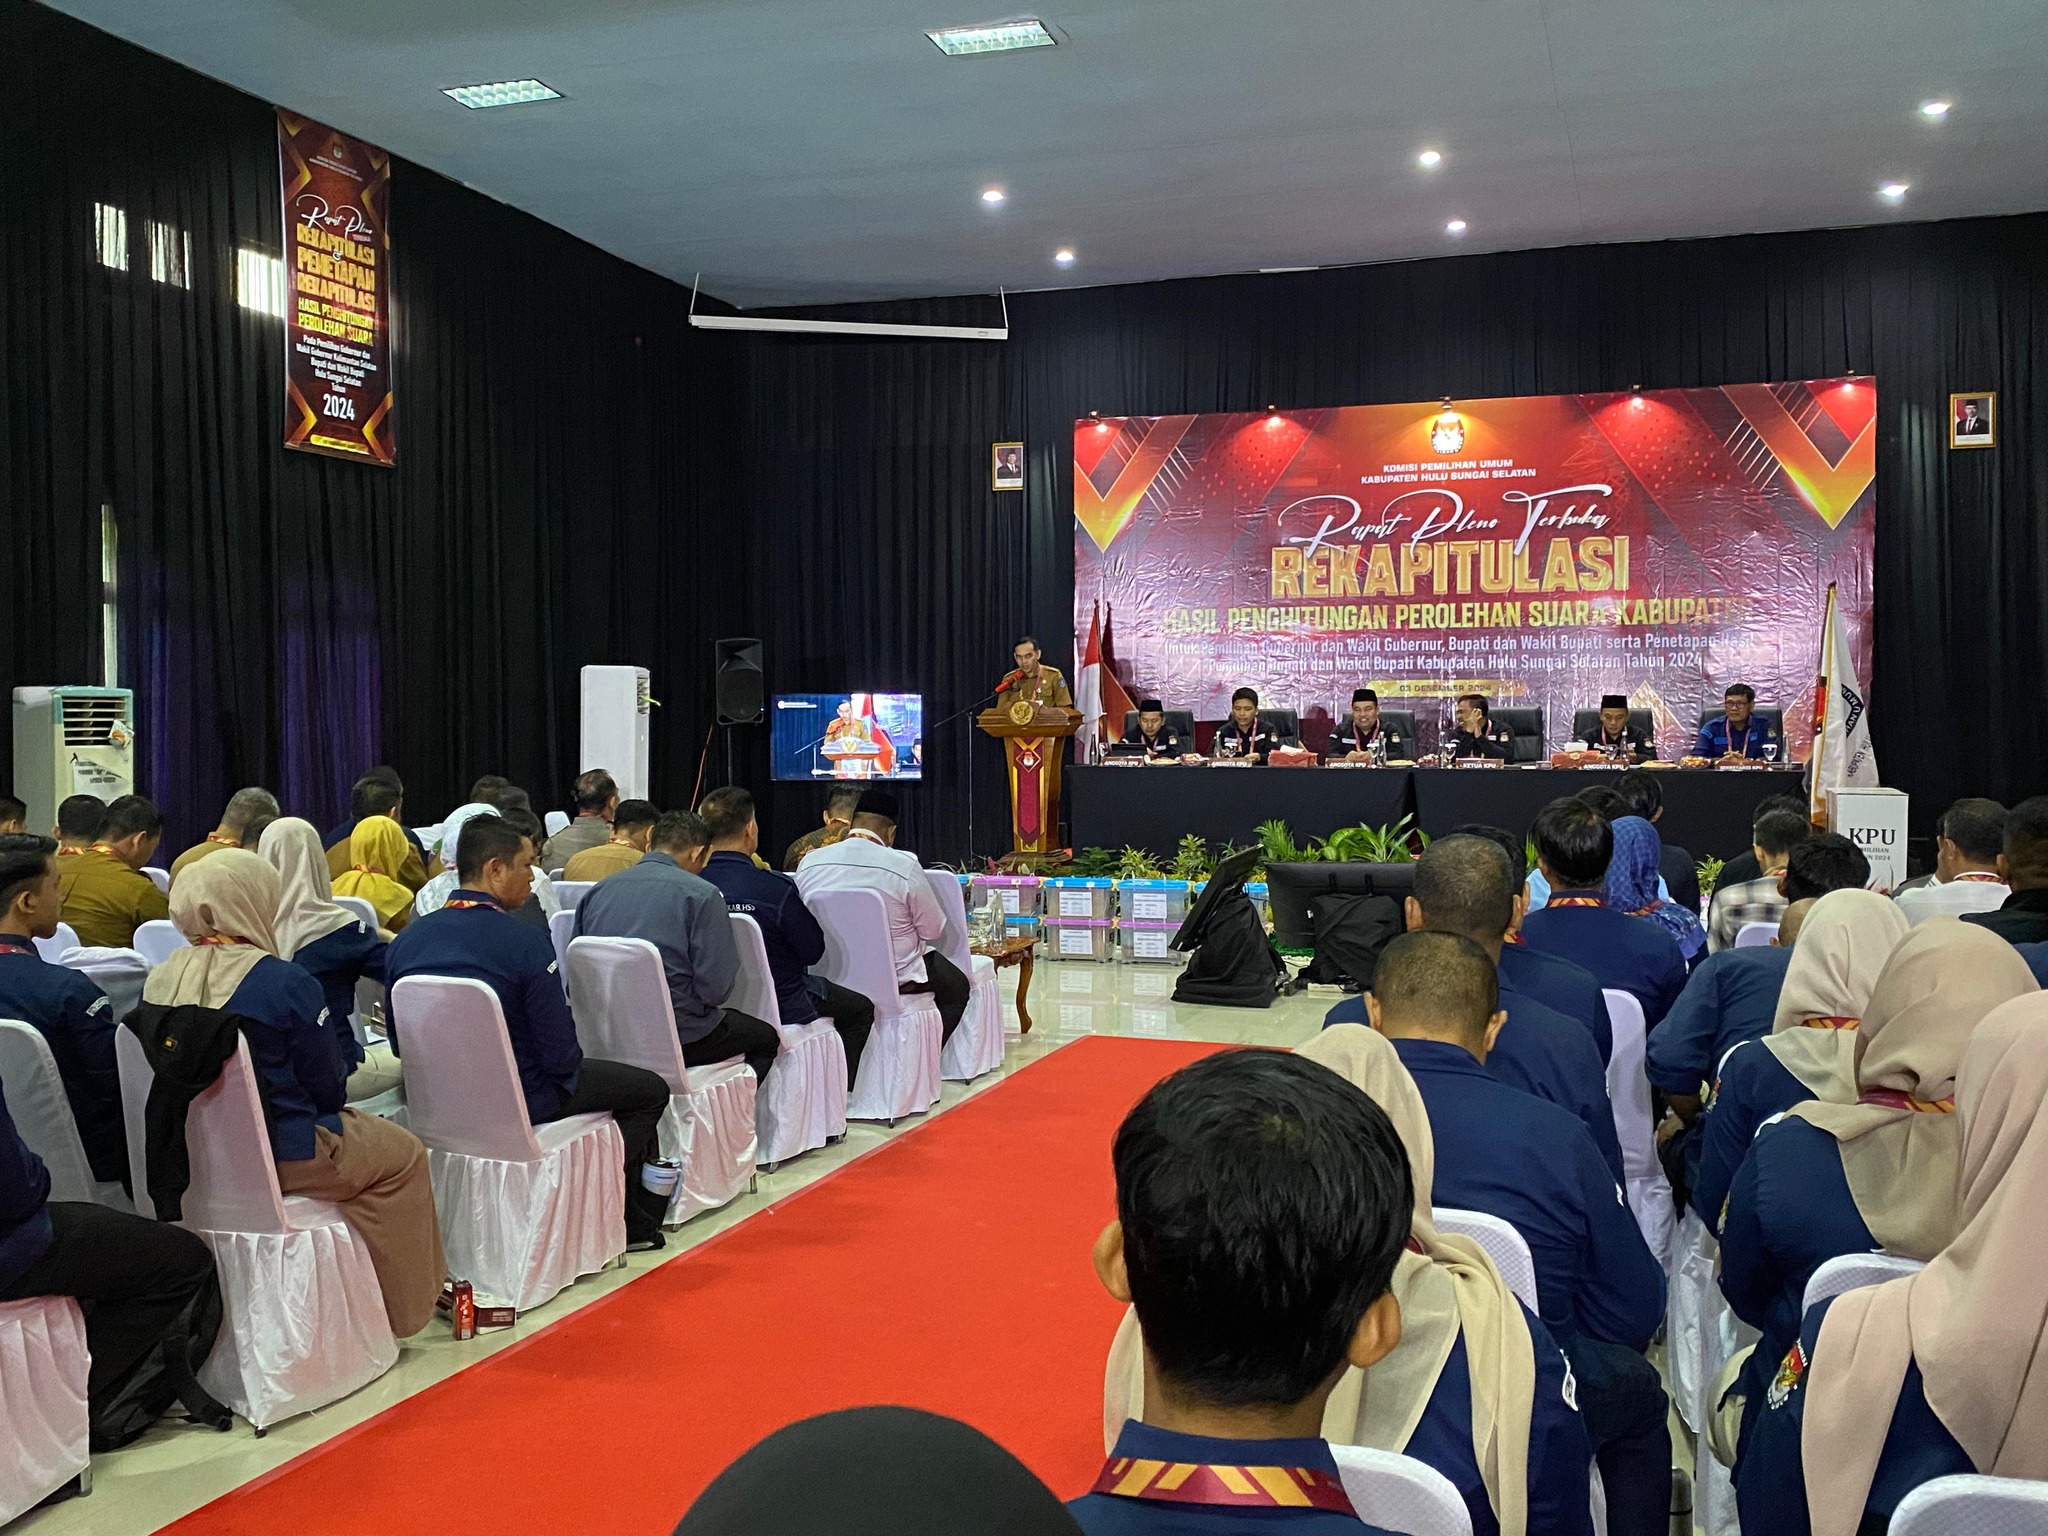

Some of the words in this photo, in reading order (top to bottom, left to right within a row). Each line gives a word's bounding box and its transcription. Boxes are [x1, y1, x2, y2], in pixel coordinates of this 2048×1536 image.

[296, 222, 375, 267] REKAPITULASI
[297, 271, 375, 313] REKAPITULASI
[298, 297, 321, 315] HASIL
[298, 312, 346, 338] PEROLEHAN
[347, 325, 374, 347] SUARA
[323, 393, 355, 421] 2024
[1361, 474, 1418, 484] KABUPATEN
[1420, 472, 1449, 482] HULU
[1450, 471, 1489, 480] SUNGAI
[1492, 468, 1537, 478] SELATAN
[1383, 464, 1418, 473] KOMISI
[1420, 461, 1477, 471] PEMILIHAN
[1479, 459, 1513, 468] UMUM
[1278, 494, 1412, 571] Rapat
[1382, 489, 1498, 559] Pleno
[1502, 483, 1613, 556] Terbuka
[1272, 535, 1630, 598] REKAPITULASI
[1228, 605, 1388, 631] PENGHITUNGAN
[1395, 602, 1521, 629] PEROLEHAN
[1201, 640, 1258, 654] Pemilihan
[1321, 640, 1344, 653] dan
[1347, 637, 1381, 652] Wakil
[1384, 637, 1445, 653] Gubernur,
[1448, 636, 1489, 654] Bupati
[1493, 635, 1517, 650] dan
[1520, 635, 1556, 650] Wakil
[1560, 634, 1601, 653] Bupati
[1606, 635, 1640, 649] serta
[1645, 633, 1716, 652] Penetapan
[1311, 658, 1334, 671] dan
[1334, 655, 1370, 671] Wakil
[1374, 655, 1413, 672] Bupati
[1416, 654, 1485, 672] Kabupaten
[1488, 654, 1517, 669] Hulu
[1520, 653, 1566, 671] Sungai
[1570, 653, 1621, 669] Selatan
[1624, 652, 1665, 668] Tahun
[1668, 652, 1703, 668] 2024
[1849, 827, 1896, 846] KPU
